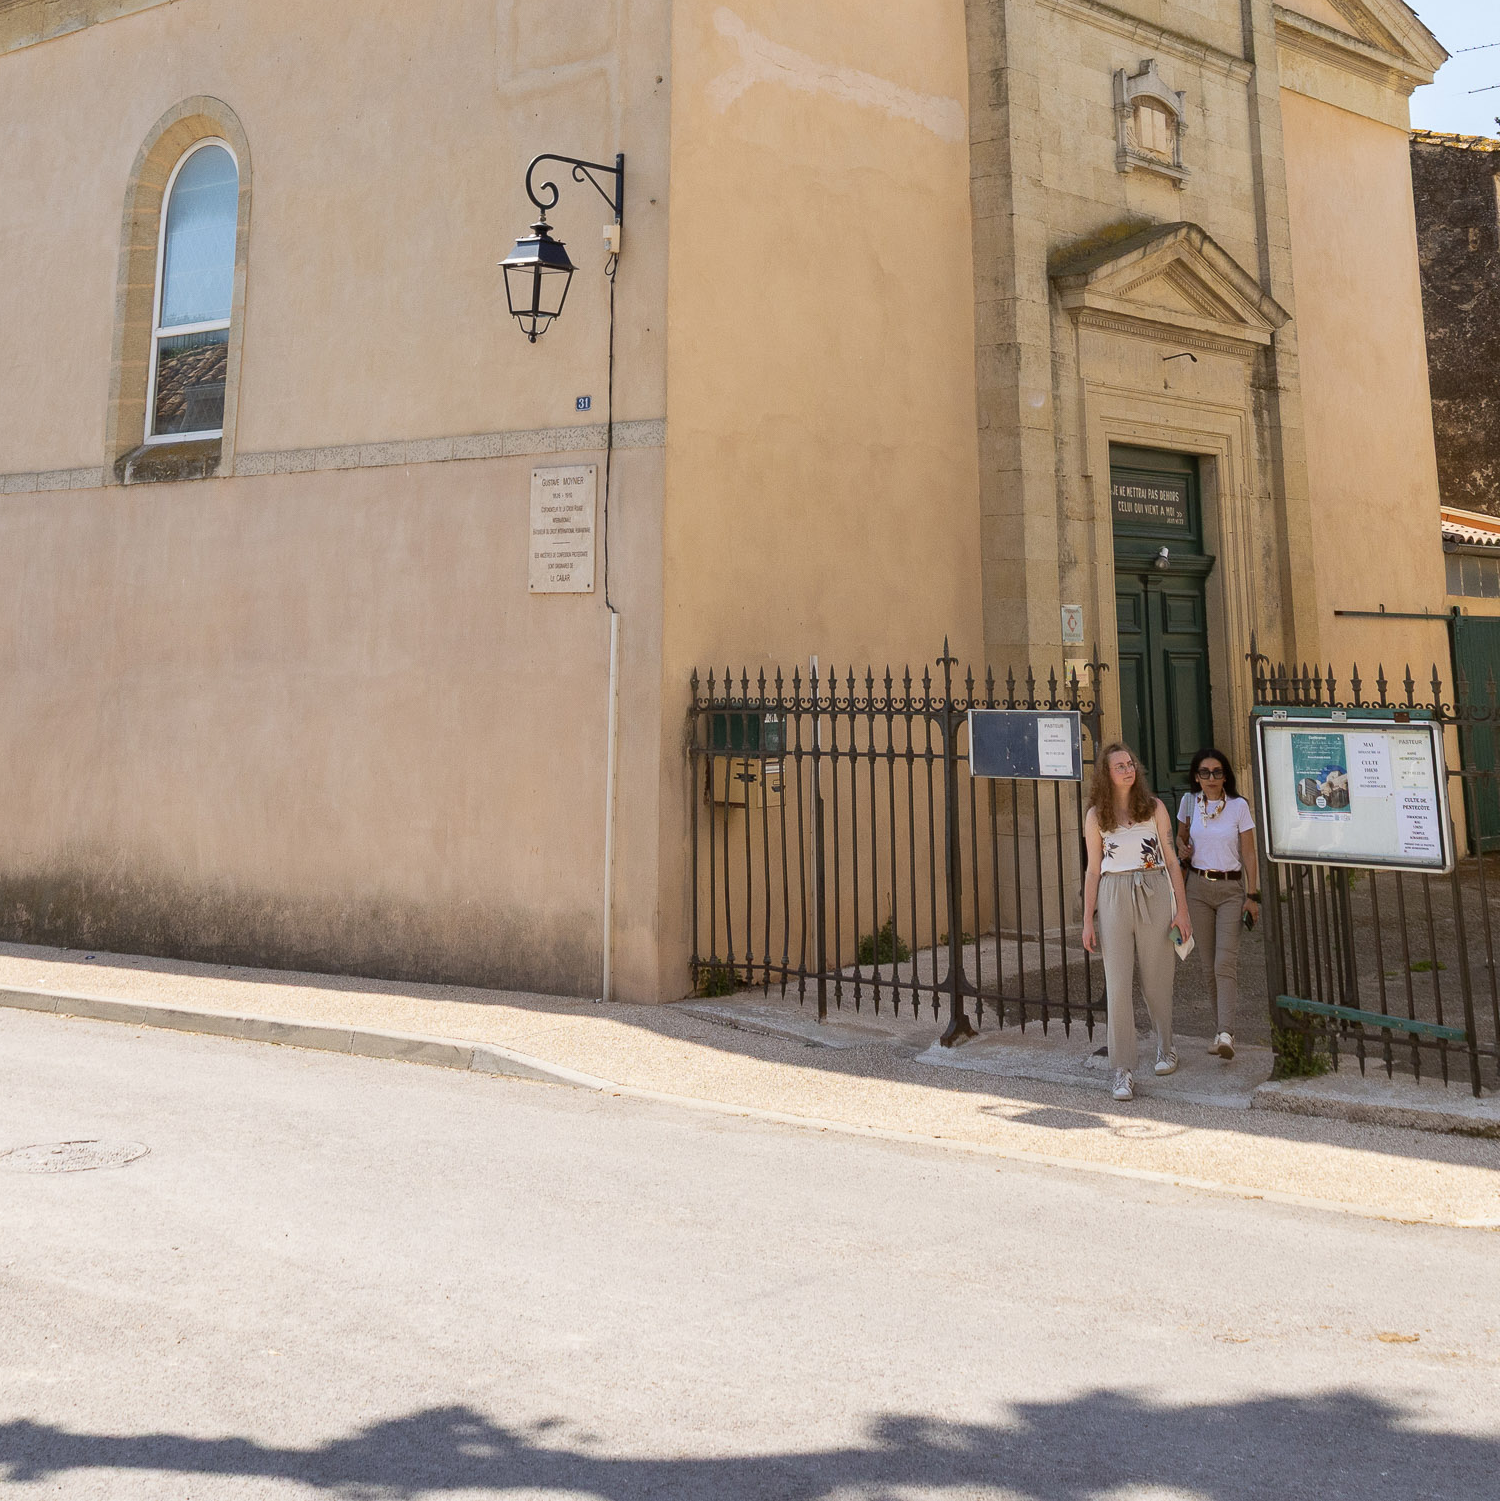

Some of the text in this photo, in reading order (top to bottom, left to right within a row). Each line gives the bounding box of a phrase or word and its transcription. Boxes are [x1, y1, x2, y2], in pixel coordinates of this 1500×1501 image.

[578, 398, 588, 408] 31
[541, 476, 584, 486] GUSTAVE MOYNIER
[1119, 486, 1126, 497] NE
[1127, 486, 1147, 499] METTRAI
[1148, 488, 1158, 500] PAS
[1159, 490, 1180, 502] DEHORS
[1118, 501, 1133, 512] CELUI
[1134, 503, 1143, 514] QUI
[1144, 504, 1159, 515] VIENT
